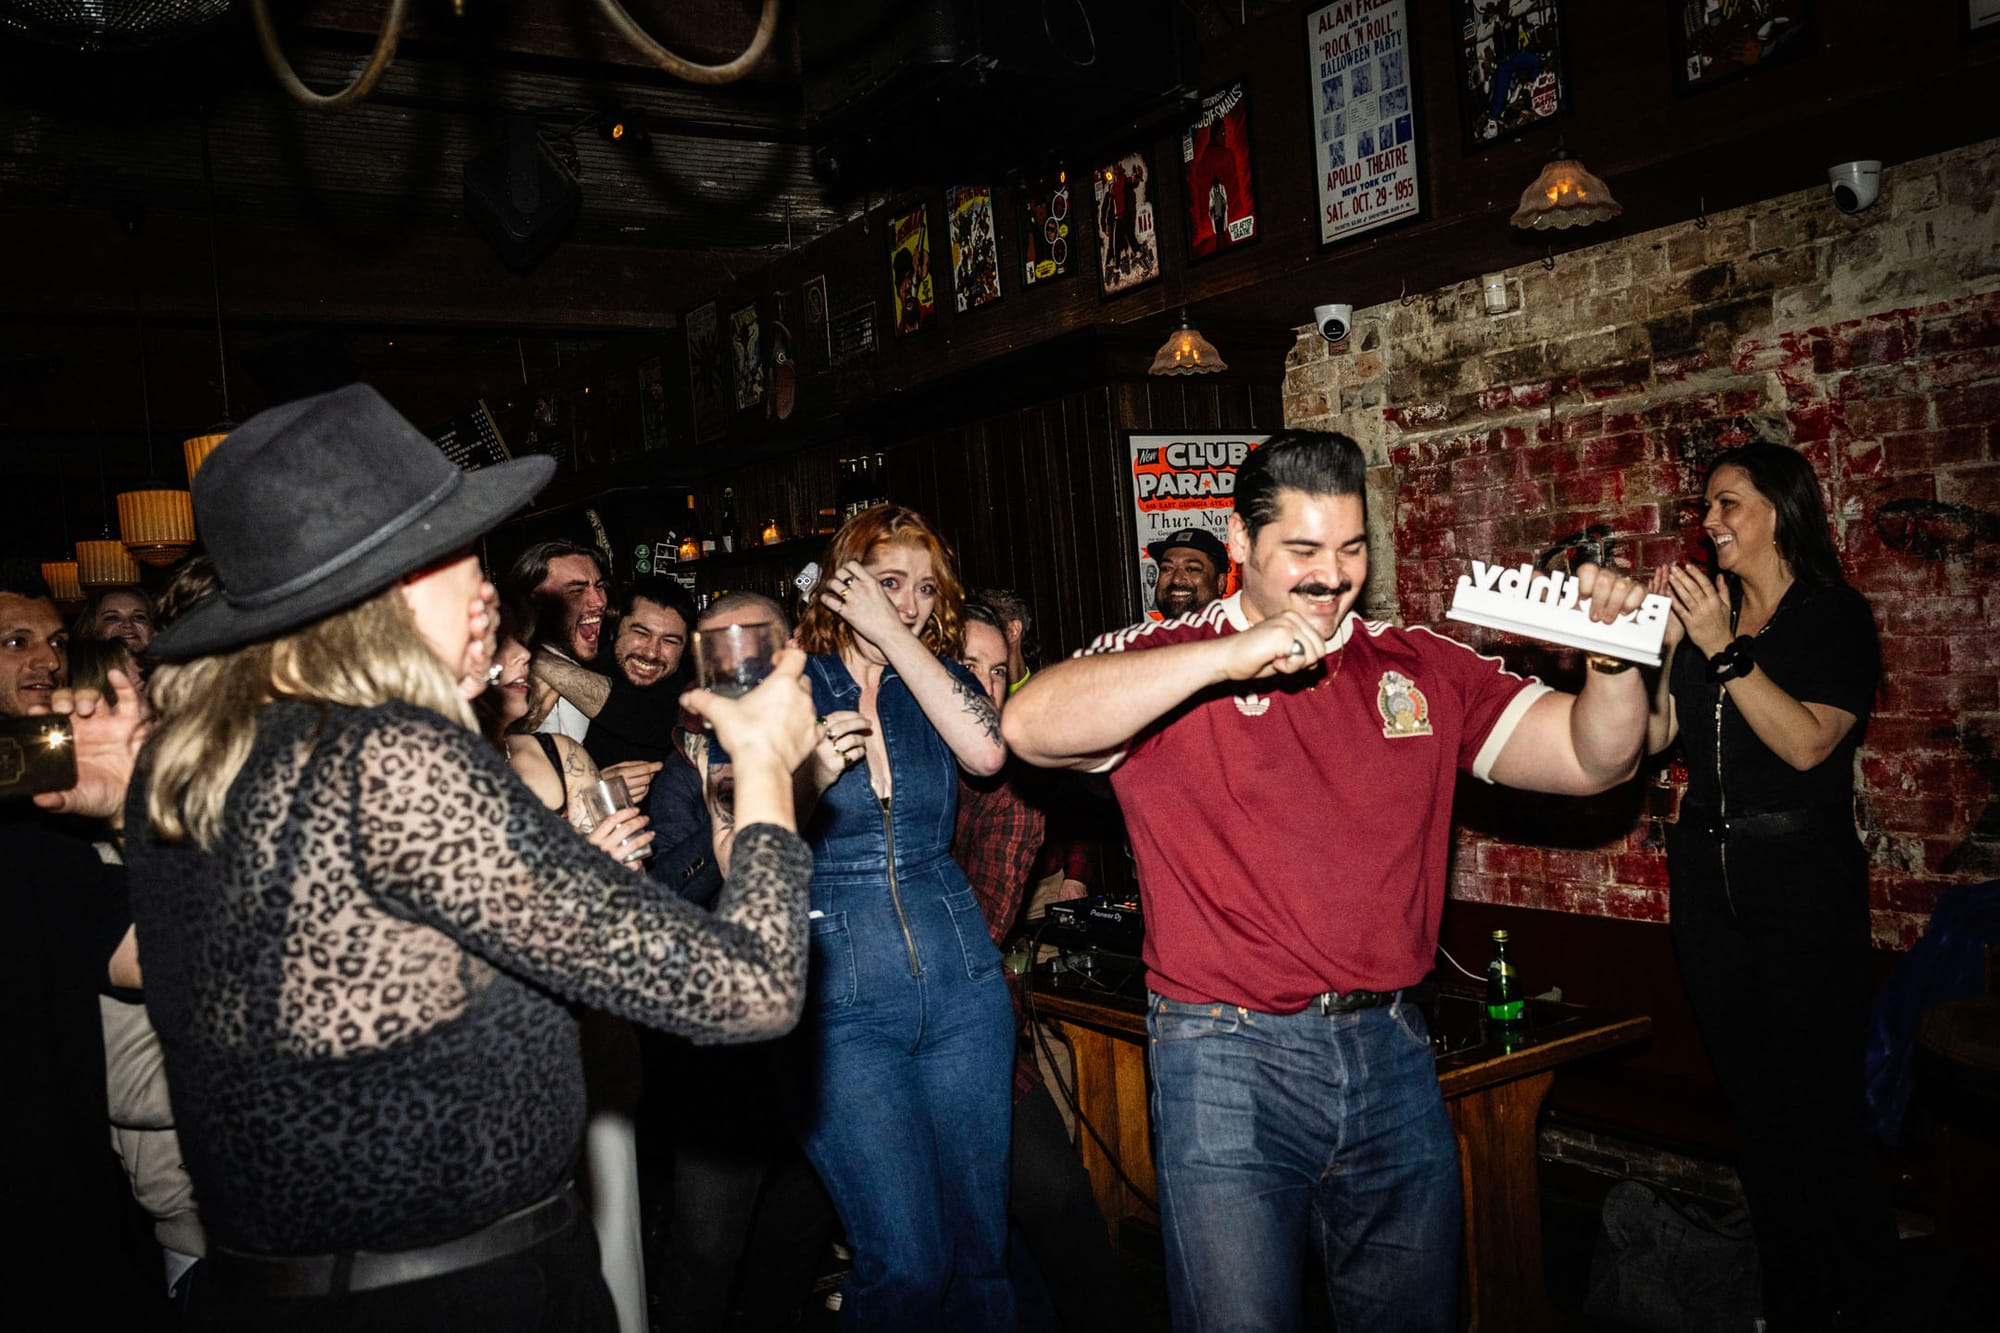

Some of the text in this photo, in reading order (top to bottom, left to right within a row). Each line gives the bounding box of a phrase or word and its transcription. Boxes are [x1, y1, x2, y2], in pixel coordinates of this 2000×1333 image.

[1318, 2, 1353, 34] ALAN
[1320, 29, 1402, 79] HALLOWEEN PARTY
[1214, 86, 1243, 119] SMALLS
[1327, 145, 1408, 192] APOLLO THEATRE
[1342, 171, 1397, 197] NEW YORK CITY
[1352, 192, 1373, 215] OCT.
[1139, 442, 1249, 468] New CLUB
[1147, 512, 1193, 529] Thur.
[1090, 908, 1122, 922] Pioneer DJ
